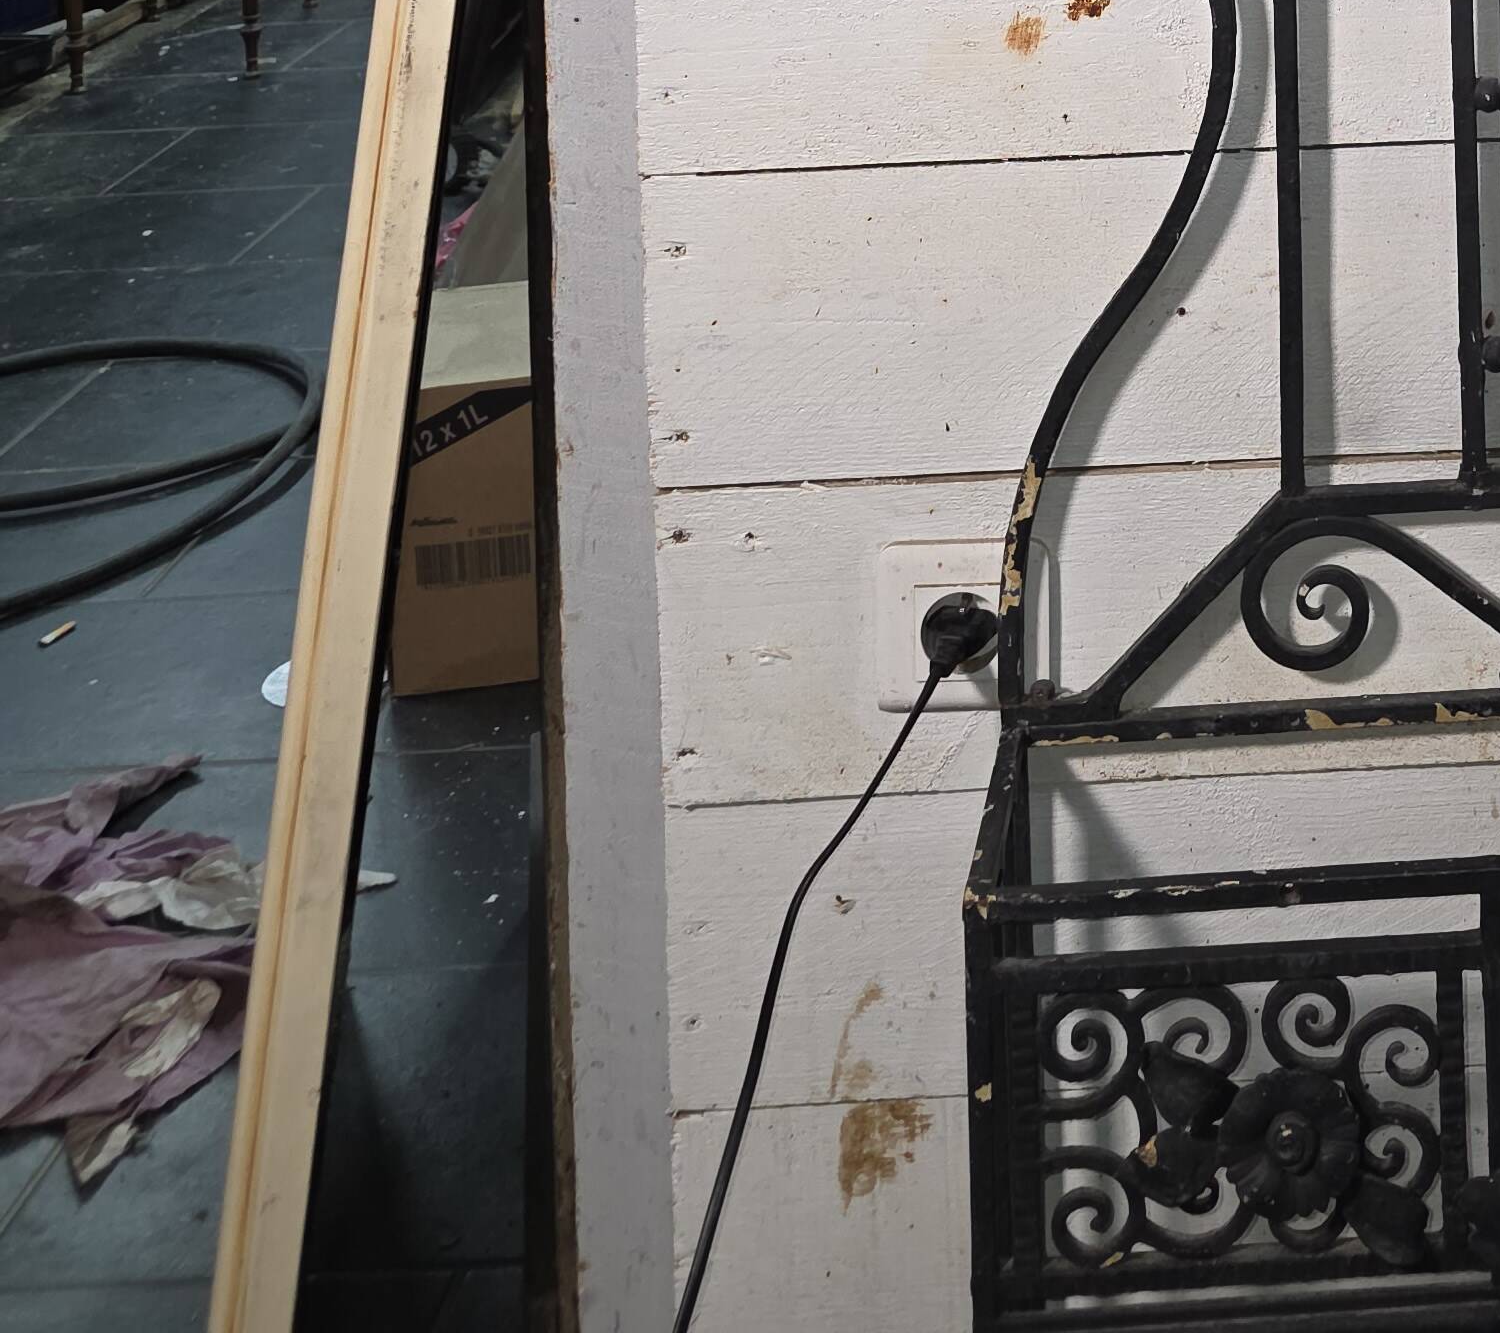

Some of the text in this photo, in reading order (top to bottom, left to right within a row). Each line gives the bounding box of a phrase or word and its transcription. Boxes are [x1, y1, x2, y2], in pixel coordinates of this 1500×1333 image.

[412, 404, 489, 457] 12 x 1L
